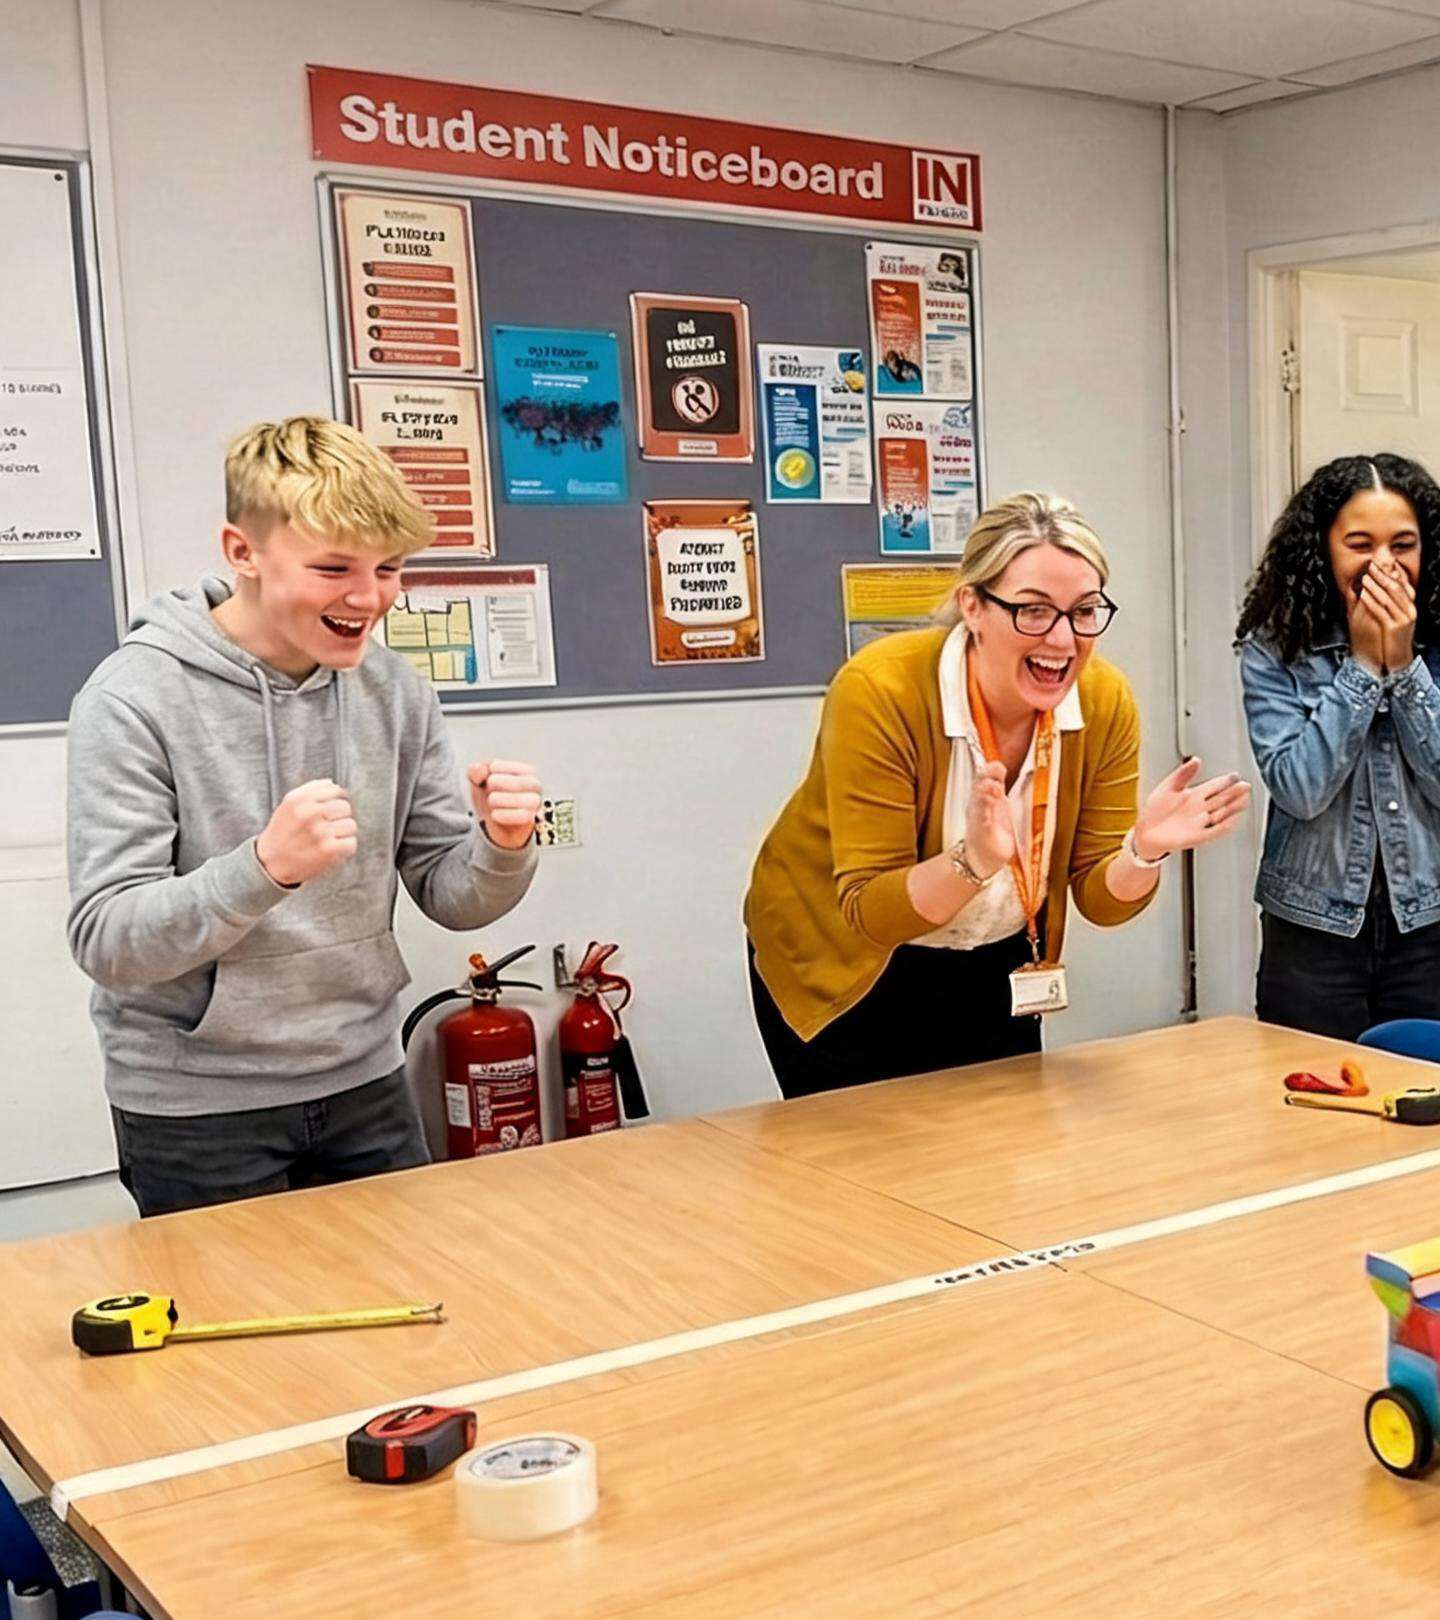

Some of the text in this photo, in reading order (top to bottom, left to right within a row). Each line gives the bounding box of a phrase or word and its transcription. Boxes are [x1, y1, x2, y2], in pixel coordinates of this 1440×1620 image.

[340, 94, 884, 199] Student Noticeboard
[917, 157, 968, 206] IN
